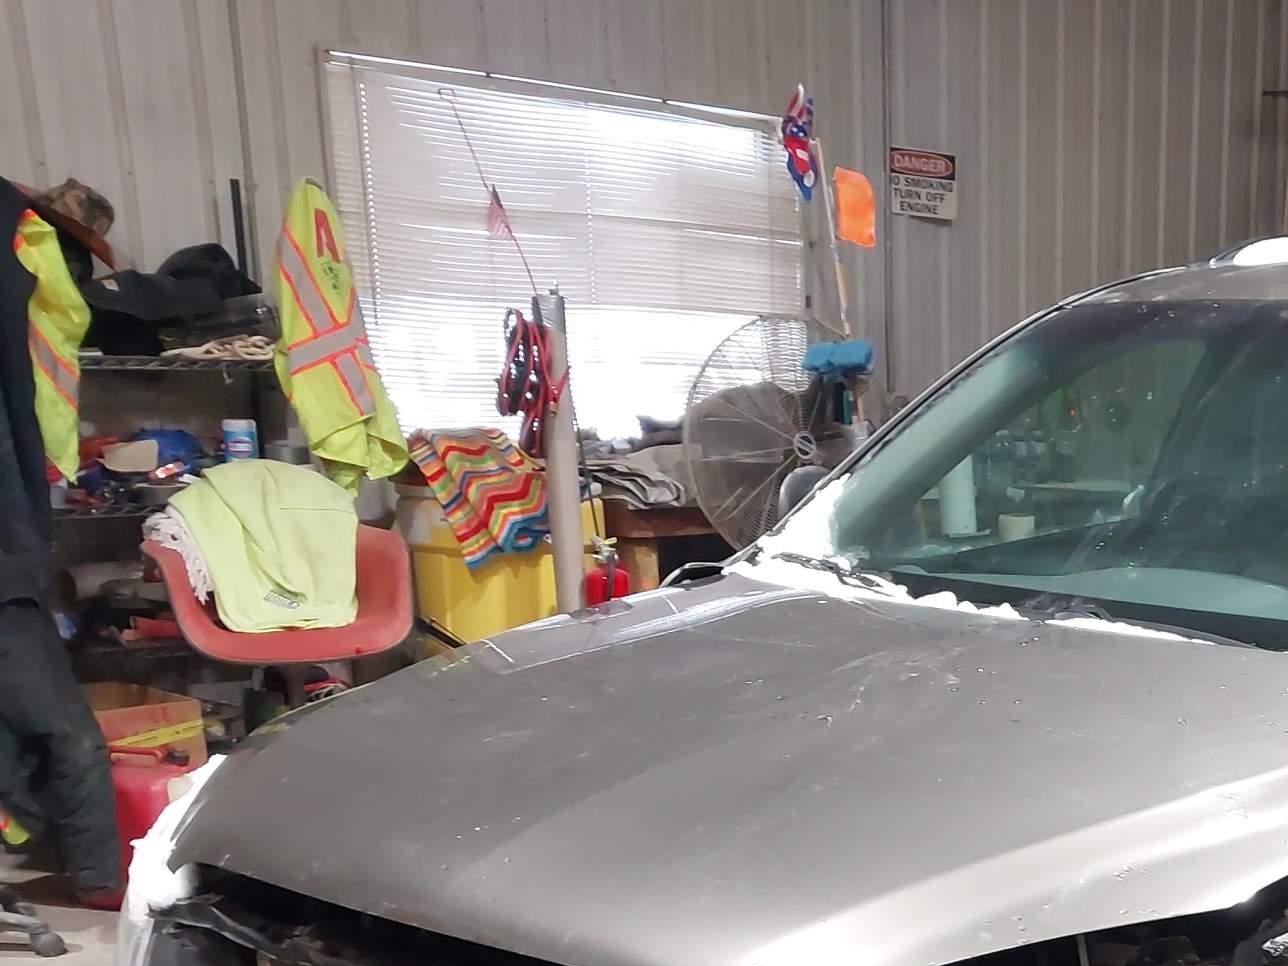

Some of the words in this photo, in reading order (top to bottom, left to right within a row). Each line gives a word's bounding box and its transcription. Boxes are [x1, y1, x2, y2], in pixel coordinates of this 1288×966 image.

[894, 154, 946, 173] DANGER
[904, 177, 953, 192] SMOKING
[893, 187, 921, 201] TURN
[926, 192, 947, 203] OFF
[899, 201, 939, 215] ENGINE
